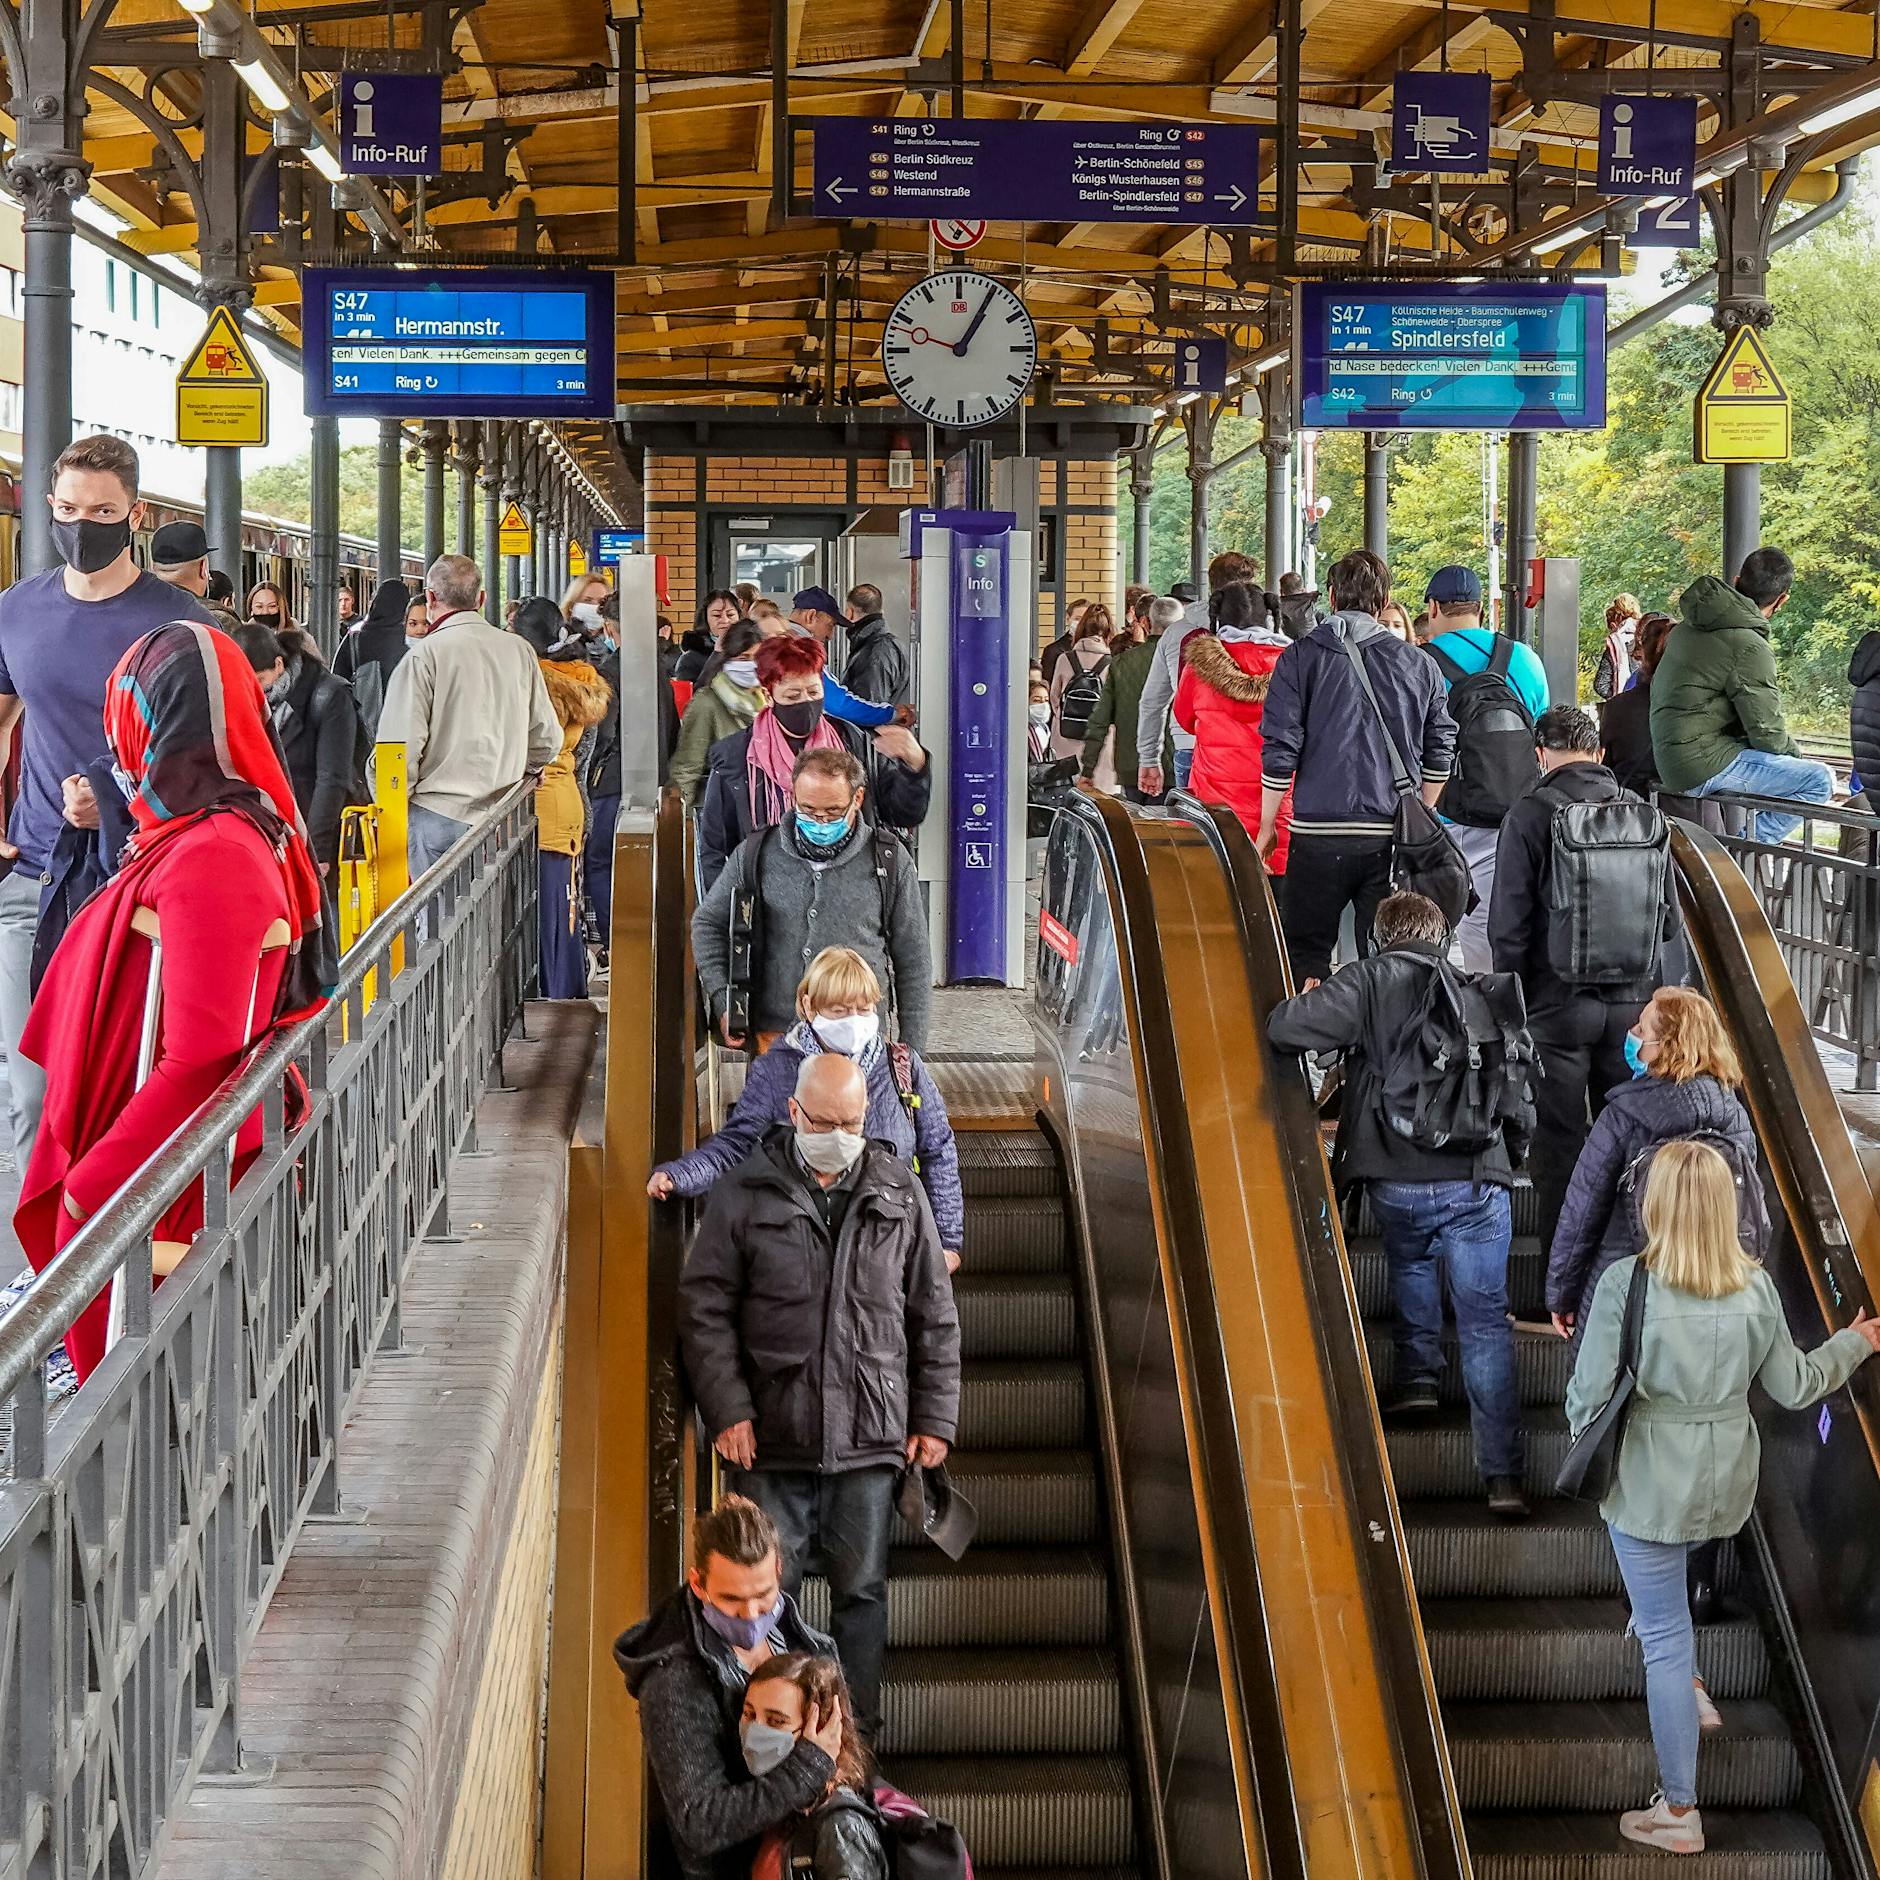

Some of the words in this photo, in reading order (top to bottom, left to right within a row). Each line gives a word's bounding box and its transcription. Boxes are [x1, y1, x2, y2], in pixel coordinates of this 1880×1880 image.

[872, 125, 888, 134] S41
[894, 125, 917, 137] Ring
[1140, 130, 1162, 142] Ring
[1186, 132, 1203, 140] S42
[352, 144, 428, 163] Info-Ruf
[894, 154, 924, 164] Berlin
[926, 154, 974, 165] Südkreuz
[1090, 158, 1180, 169] Berlin-Schönefeld
[893, 170, 937, 180] Westend
[1072, 173, 1106, 186] Königs
[1109, 174, 1180, 186] Wusterhausen
[1610, 165, 1682, 185] Info-Ruf
[871, 186, 887, 195] S47
[893, 186, 971, 197] Hermannstraße
[1079, 190, 1180, 202] Berlin-Spindlersfeld
[1186, 193, 1202, 201] S47
[1655, 197, 1690, 229] 2
[334, 292, 368, 310] S47
[952, 302, 966, 312] DB
[334, 312, 344, 321] in
[347, 313, 354, 321] 3
[356, 312, 376, 321] min
[1331, 306, 1364, 323] S47
[1391, 306, 1438, 315] Köllnische
[1439, 307, 1463, 316] Heide
[1471, 306, 1548, 318] Baumschulenweg
[395, 317, 505, 336] Hermannstr.
[1391, 317, 1449, 326] Schöneweide
[1457, 317, 1502, 328] Oberspree
[1331, 325, 1341, 334] in
[1345, 326, 1350, 334] 1
[1353, 325, 1372, 334] min
[1391, 330, 1505, 351] Spindlersfeld
[359, 348, 394, 359] Vielen
[400, 348, 433, 359] Dank.
[535, 351, 570, 362] gegen
[575, 348, 587, 360] C
[1346, 360, 1375, 371] Nase
[1380, 360, 1440, 371] bedecken!
[1445, 361, 1480, 372] Vielen
[1485, 361, 1518, 372] Dank.
[335, 376, 358, 388] S41
[396, 376, 421, 392] Ring
[556, 380, 564, 389] 3
[566, 380, 585, 389] min
[1331, 388, 1355, 400] S42
[1391, 388, 1416, 403] Ring
[1548, 392, 1554, 401] 3
[1558, 392, 1576, 401] min
[976, 554, 986, 567] S
[968, 577, 994, 590] Info
